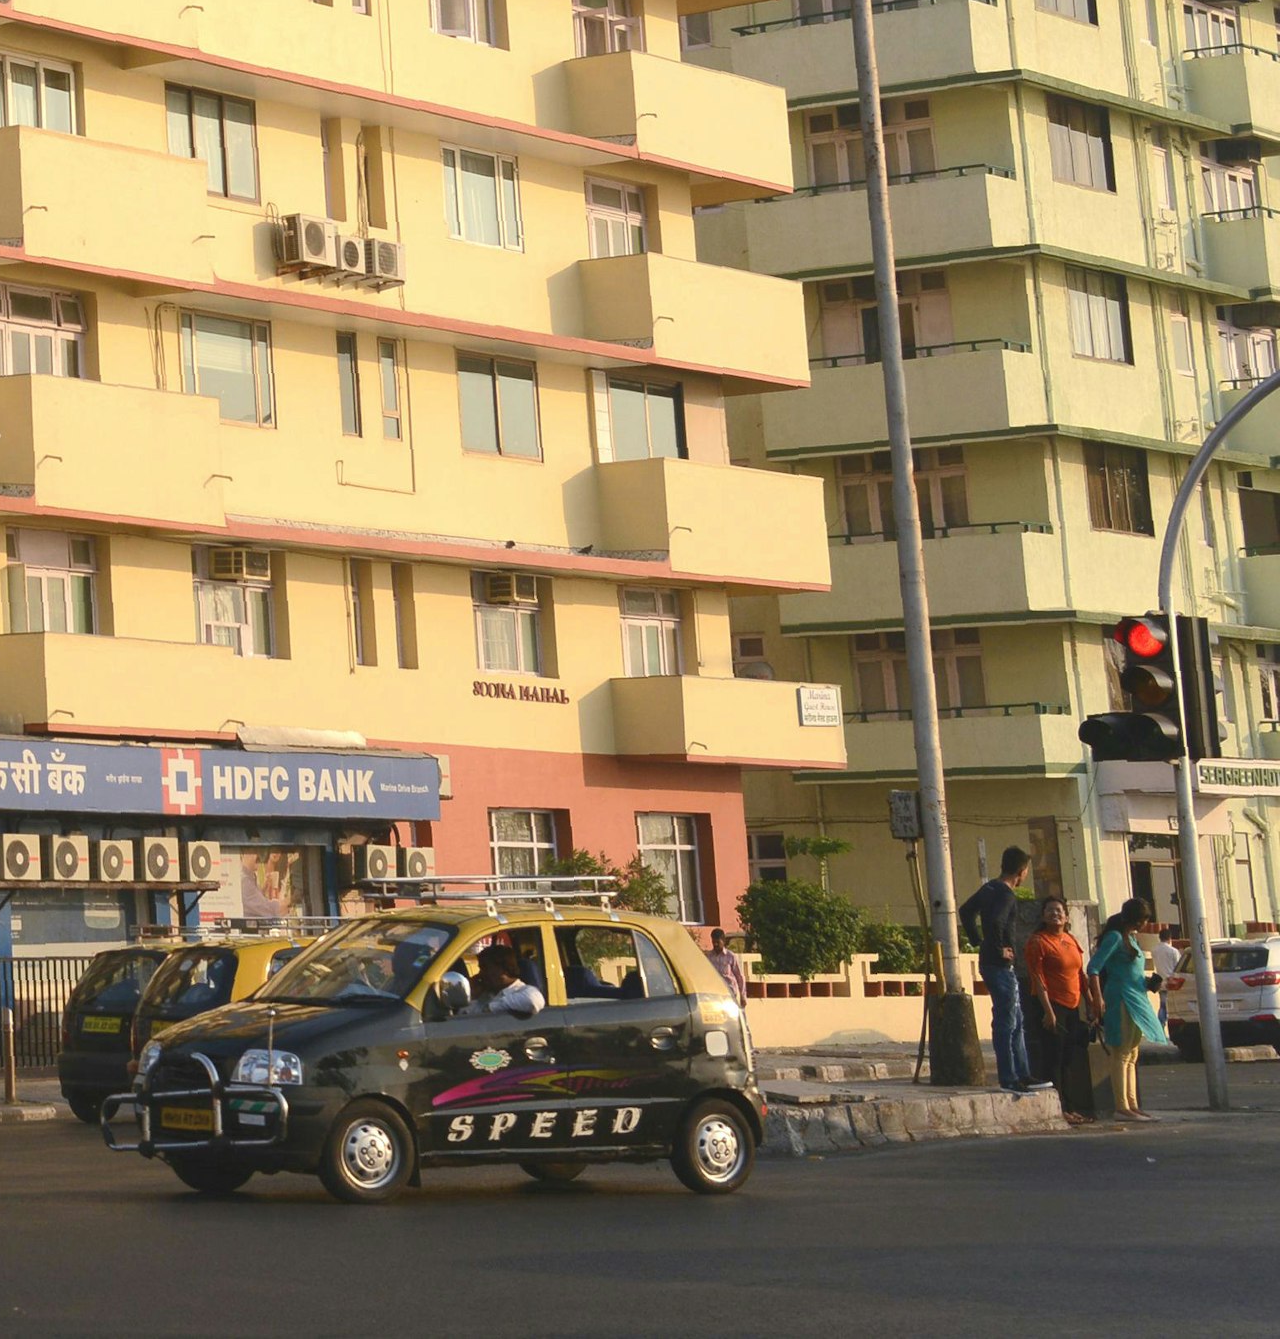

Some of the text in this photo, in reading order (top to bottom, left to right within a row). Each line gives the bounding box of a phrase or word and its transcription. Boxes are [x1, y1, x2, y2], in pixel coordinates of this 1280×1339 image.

[519, 685, 570, 704] MAHAL
[47, 748, 86, 795] बँक
[212, 766, 376, 803] HDFC BANK
[380, 783, 397, 793] Marine
[447, 1107, 642, 1142] SPEED
